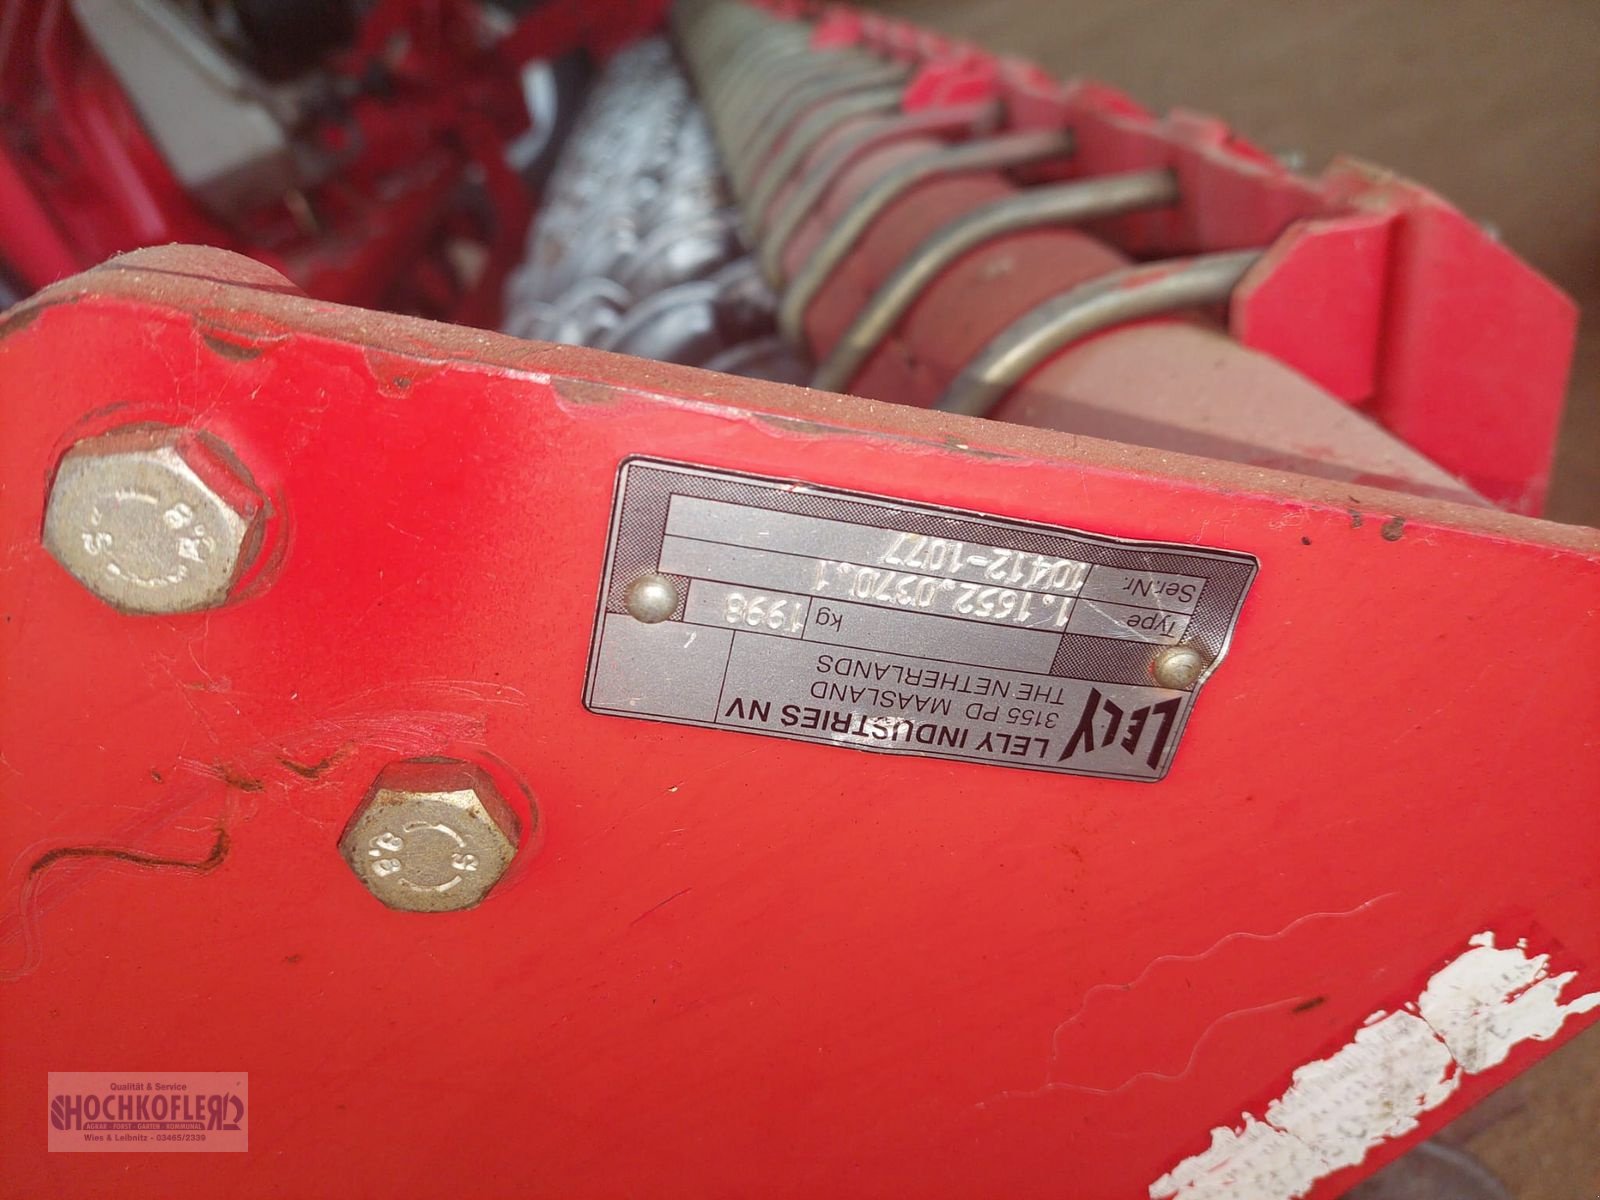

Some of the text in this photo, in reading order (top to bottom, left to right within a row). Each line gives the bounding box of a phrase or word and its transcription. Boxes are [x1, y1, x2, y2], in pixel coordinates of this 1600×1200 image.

[881, 531, 1087, 591] 10412-1077
[724, 592, 803, 633] 1998
[815, 606, 843, 632] kg
[1127, 614, 1176, 639] Type
[816, 654, 1065, 705] THE NETHERLANDS
[725, 697, 1050, 758] LELY INDUSTRIES NV
[810, 681, 1060, 729] 3155 PD MAASLAND
[1057, 687, 1182, 770] LELY
